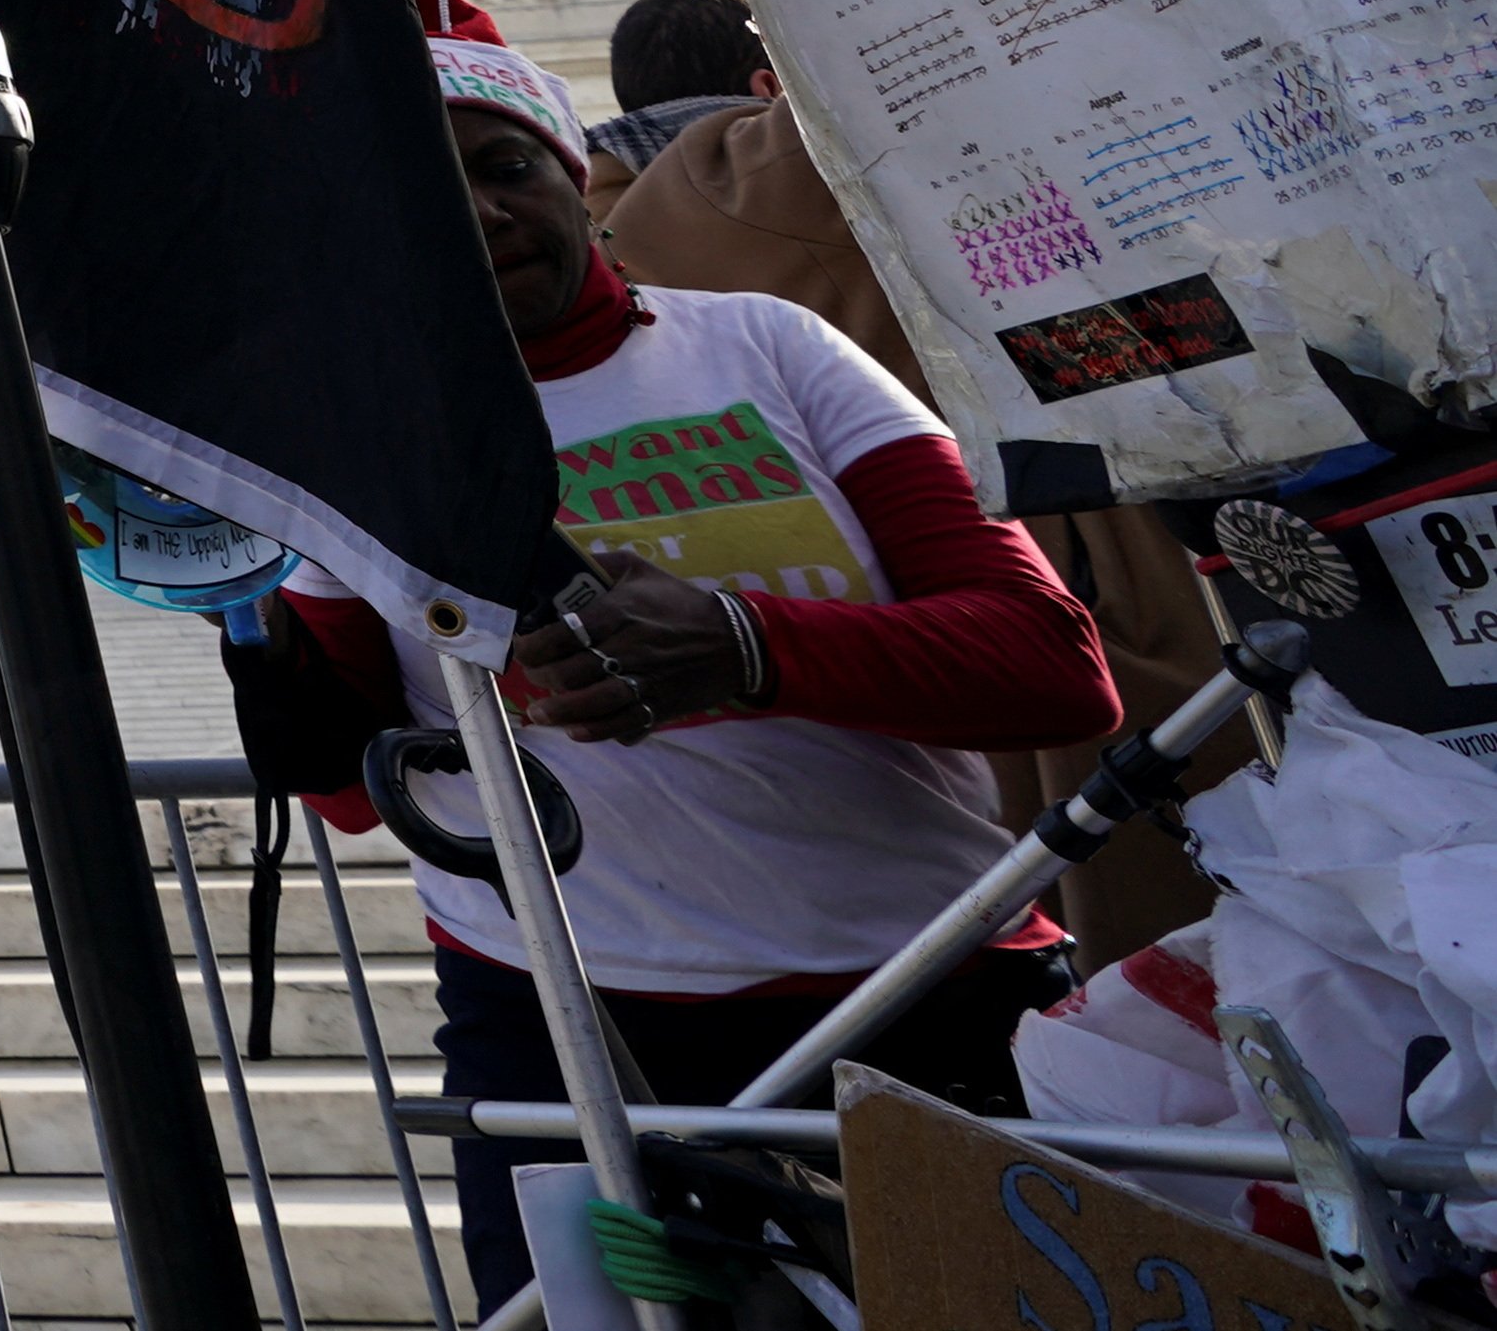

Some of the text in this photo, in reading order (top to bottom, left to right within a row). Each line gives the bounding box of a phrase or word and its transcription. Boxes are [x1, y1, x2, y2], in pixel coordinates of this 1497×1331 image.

[1089, 89, 1128, 112] August
[1232, 512, 1319, 556] OUR
[1238, 536, 1324, 573] RIGHTS
[1251, 557, 1335, 610] DC
